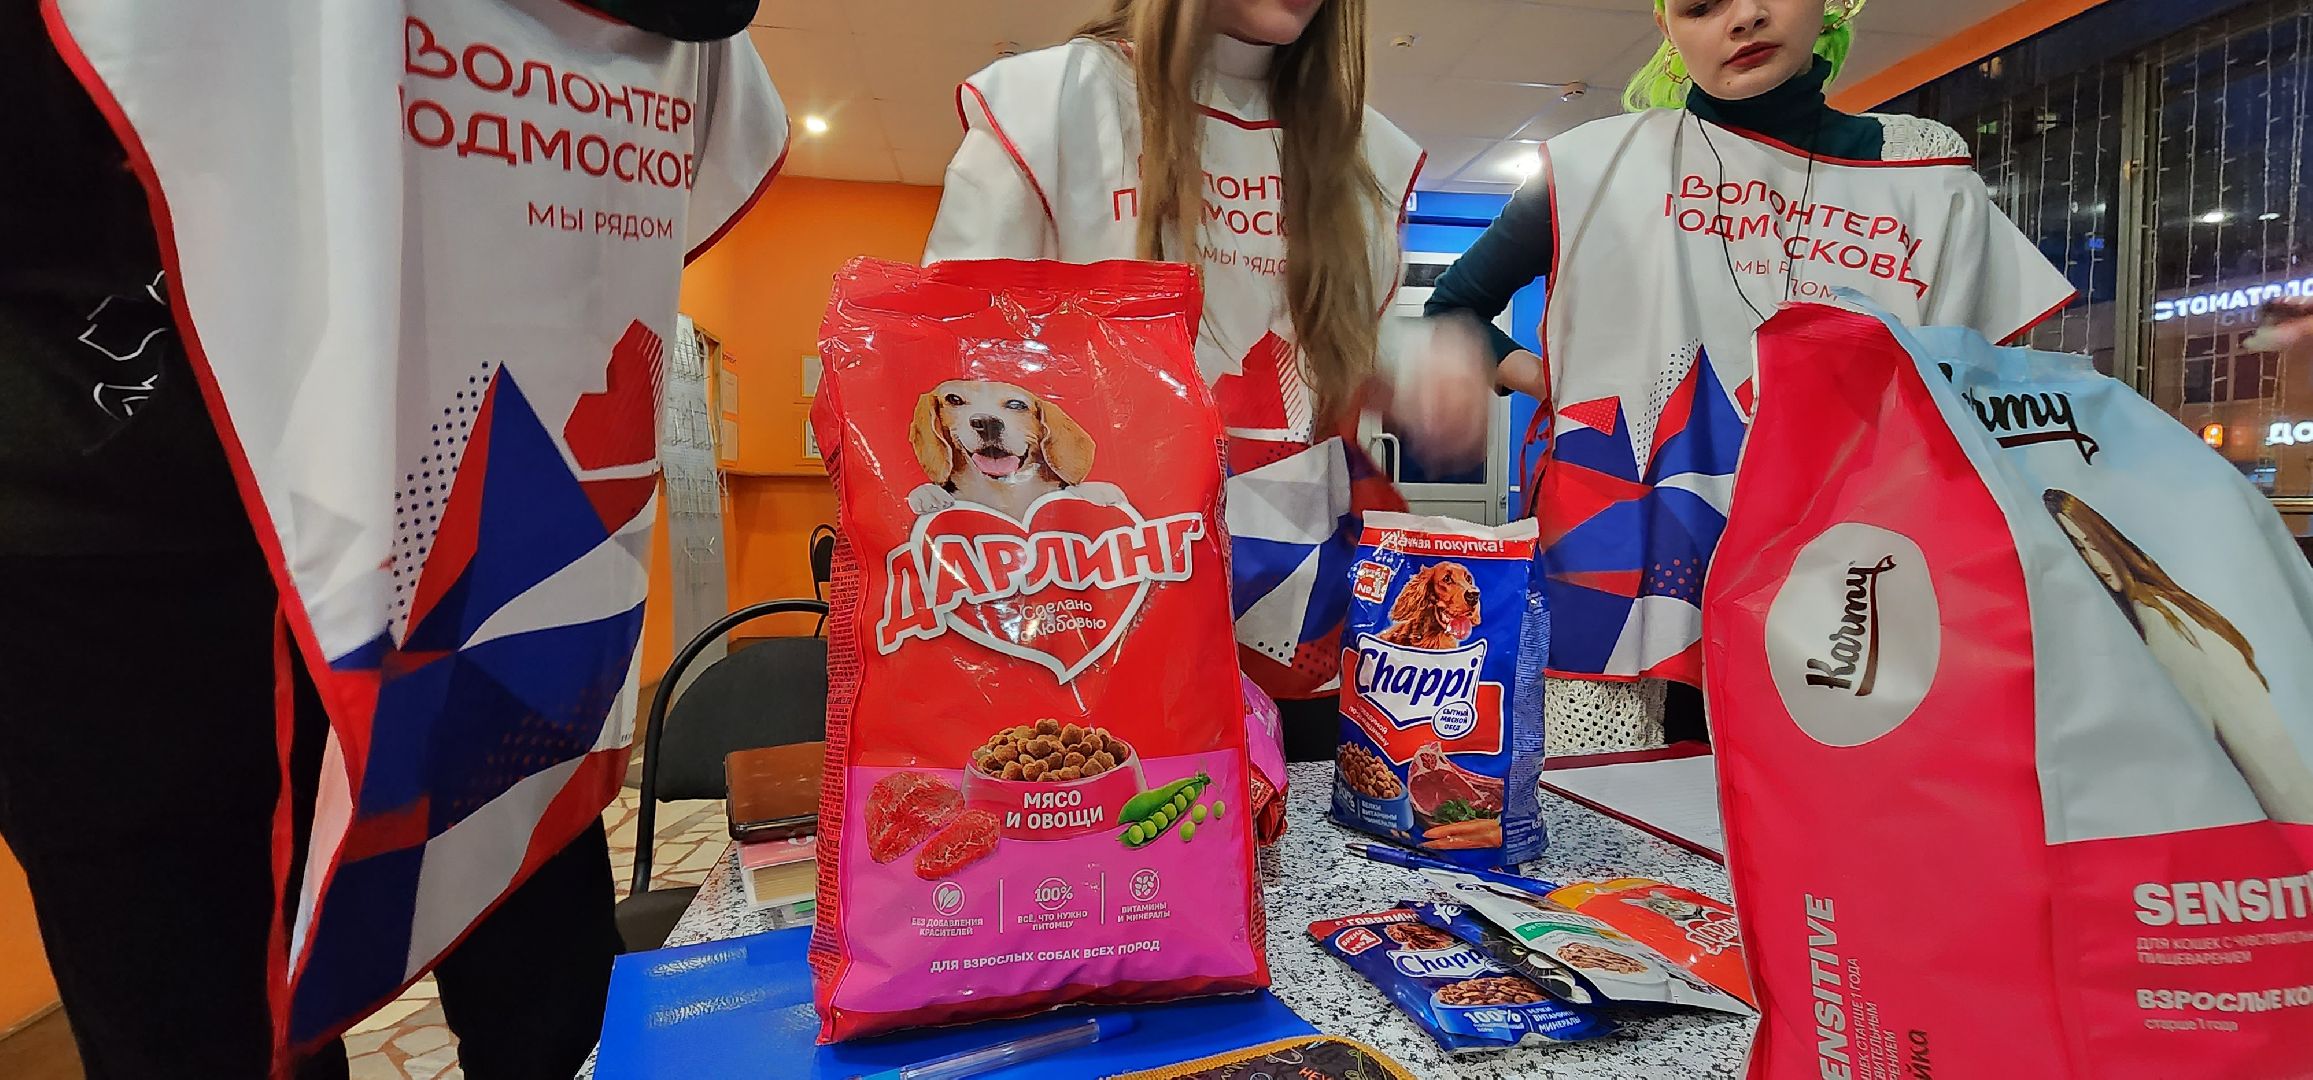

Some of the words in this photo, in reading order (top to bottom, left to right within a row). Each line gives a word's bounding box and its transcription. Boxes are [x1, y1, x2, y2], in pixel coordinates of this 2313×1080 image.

[404, 16, 697, 133] ВОЛОНТЕР
[528, 201, 584, 232] МЫ
[594, 210, 673, 241] РЯДОМ
[1680, 175, 1923, 260] ВОЛОНТЕРЫ
[1735, 260, 1770, 275] МЫ
[1435, 538, 1505, 554] покупка!
[878, 513, 1204, 654] ДАРЛИНГ
[1022, 599, 1093, 620] Сделано
[1805, 555, 1897, 697] Karmy
[1357, 648, 1478, 706] Chappi
[1023, 789, 1082, 809] МЯСО
[1005, 811, 1021, 828] И
[1027, 805, 1104, 830] ОВОЩИ
[1034, 885, 1074, 902] 100%
[911, 917, 926, 926] БЕЗ
[926, 918, 984, 927] ДОБАВЛЕНИЯ
[1032, 921, 1074, 931] ПИТОМЦУ
[1038, 913, 1055, 923] ЧТО
[1057, 910, 1088, 920] НУЖНО
[1126, 910, 1171, 923] МИНЕРАЛЫ
[919, 927, 974, 936] КРАСИТЕЛЕЙ
[930, 959, 959, 973] ДЛЯ
[963, 952, 1034, 969] ВЗРОСЛЫХ
[1037, 948, 1080, 961] СОБАК
[1084, 946, 1115, 959] ВСЕХ
[1118, 940, 1161, 956] ПОРОД
[1397, 949, 1484, 977] Chapp
[1804, 893, 1851, 1080] ENSITIVE
[1847, 958, 1863, 991] ГОДА
[1851, 991, 1862, 999] 1
[2136, 988, 2282, 1012] ВЗРОСЛЫЕ
[2282, 984, 2313, 1007] КО
[1464, 1009, 1521, 1023] 100%
[1538, 1016, 1582, 1034] МИНЕРАЛЫ
[1851, 1000, 1867, 1051] СТАРШЕ
[1866, 1001, 1884, 1080] ВИТЕЛЬНЫМ
